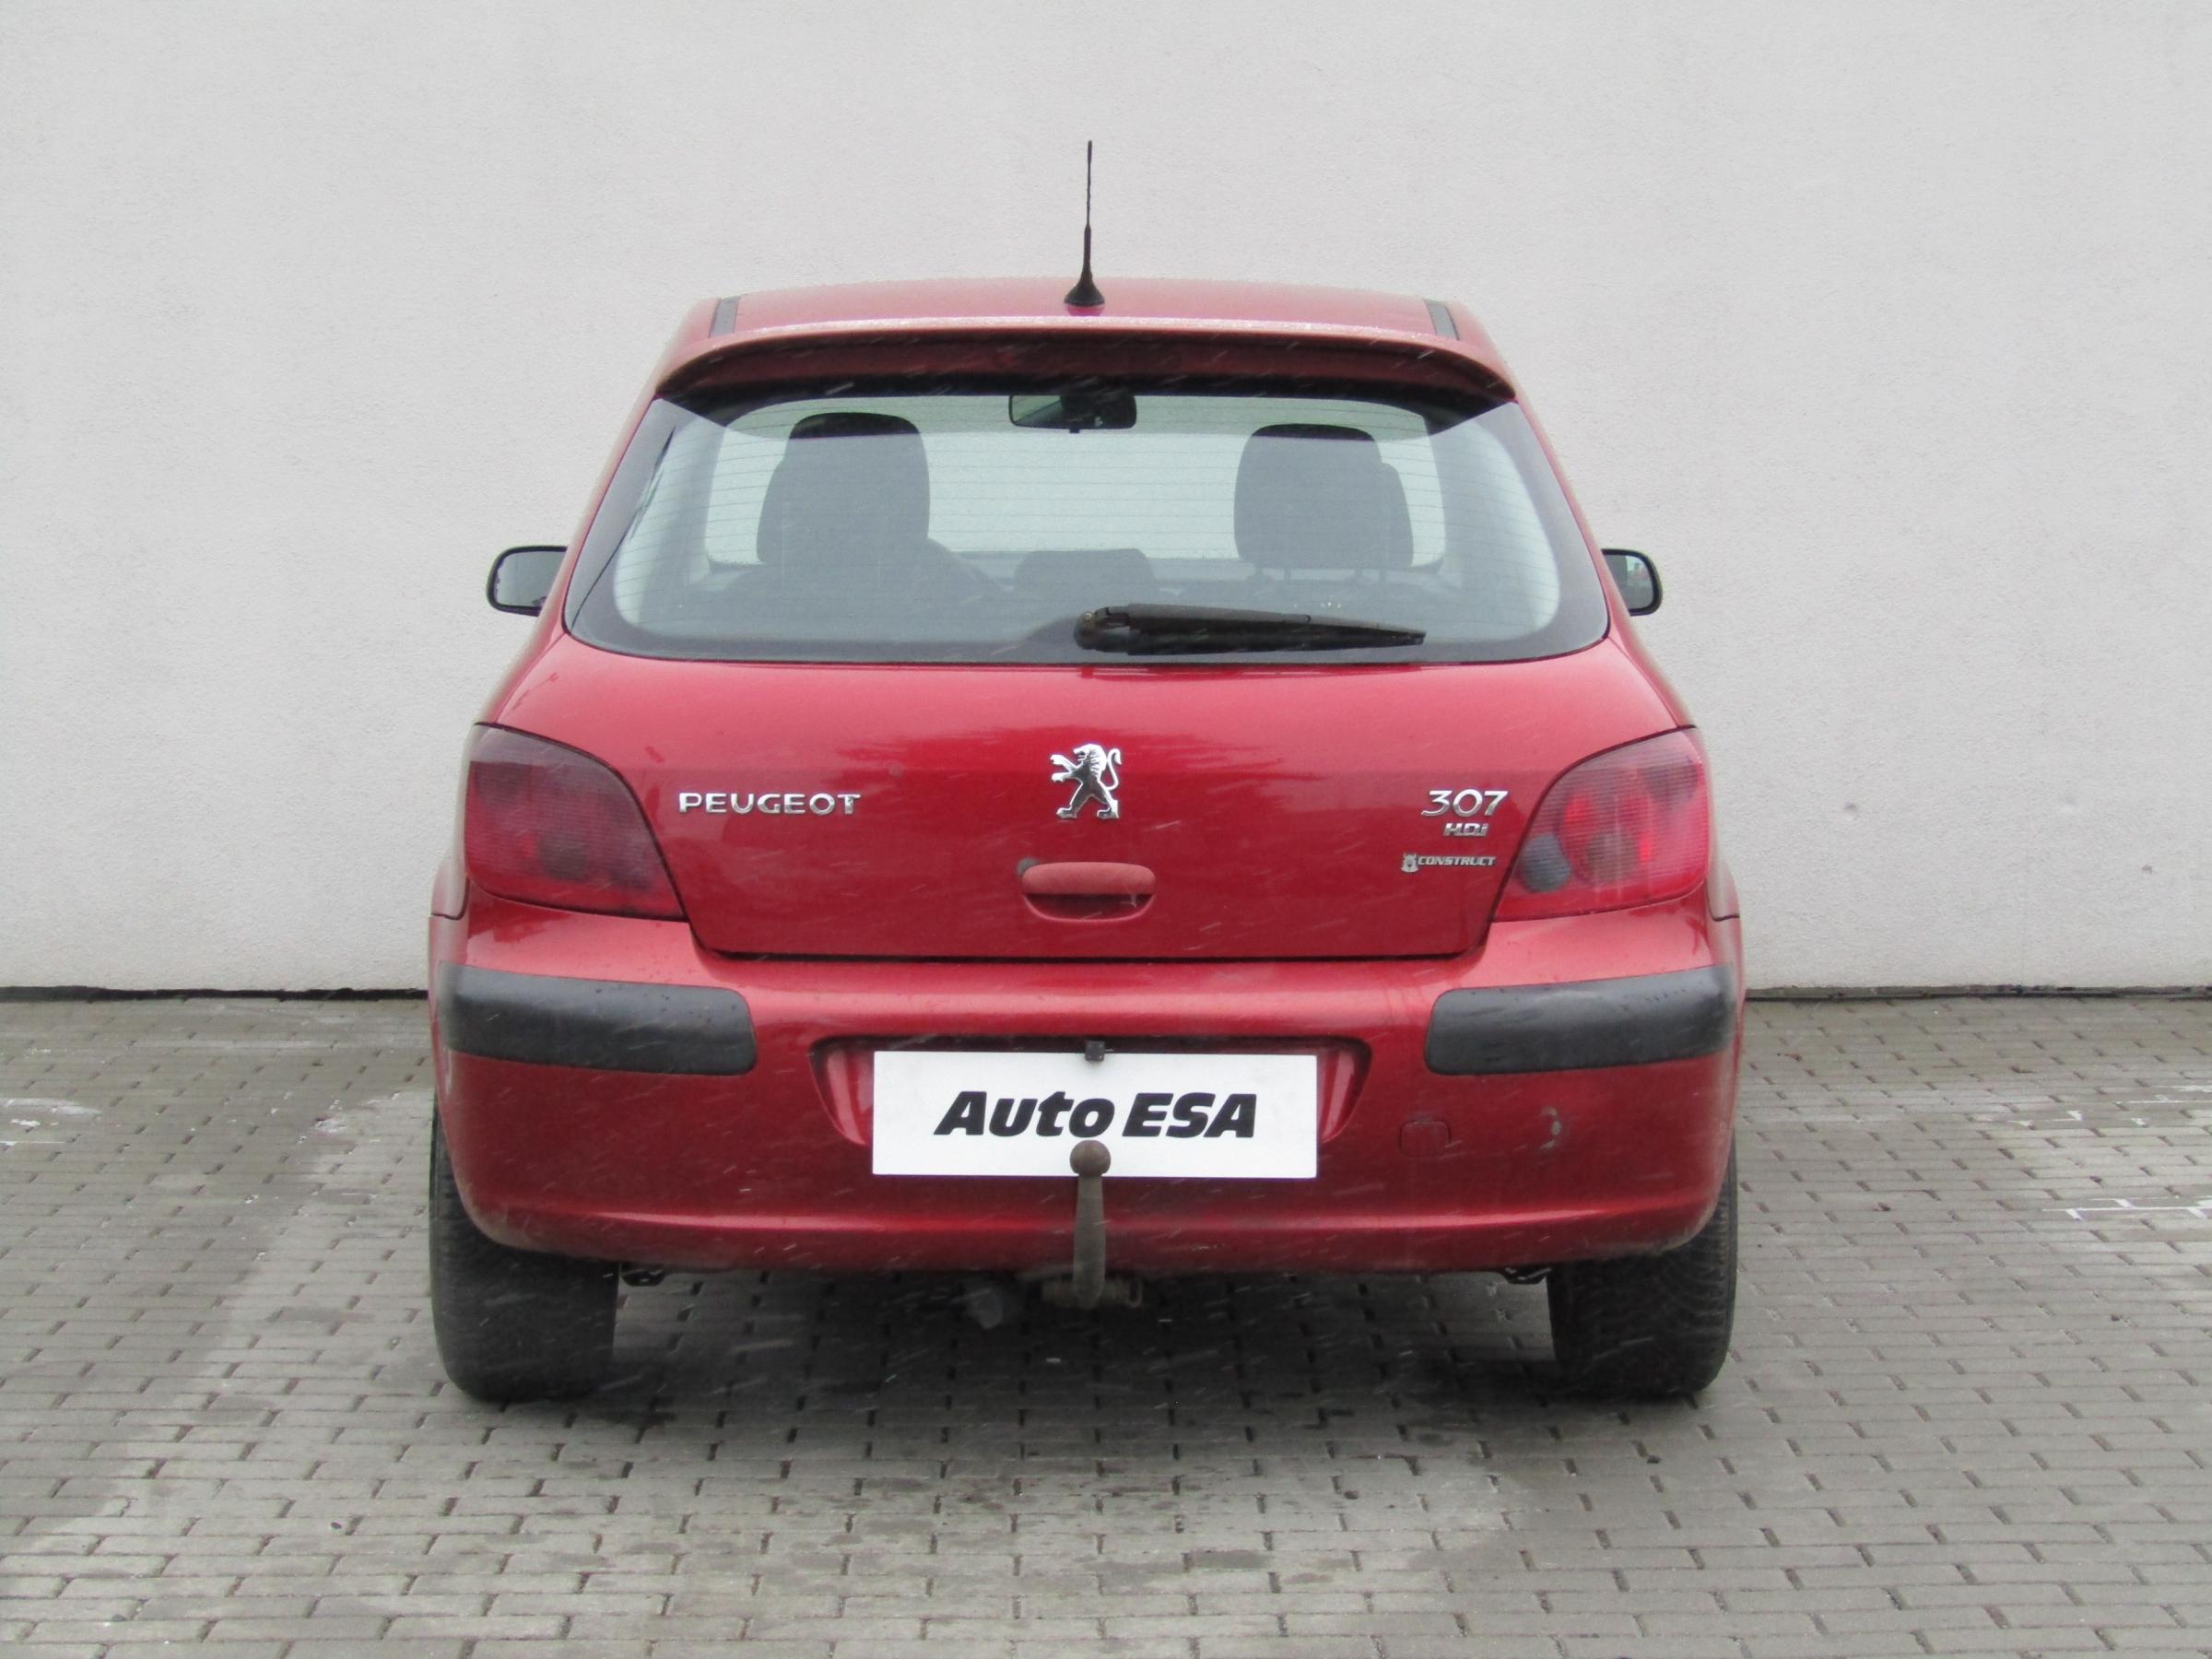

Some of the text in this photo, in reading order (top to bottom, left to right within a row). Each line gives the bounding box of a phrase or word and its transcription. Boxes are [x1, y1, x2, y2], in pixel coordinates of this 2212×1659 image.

[678, 792, 862, 816] PEUGEOT
[1421, 788, 1509, 818] 307
[1418, 855, 1497, 866] CONSTRUCT
[934, 1091, 1257, 1138] Auto ESA
